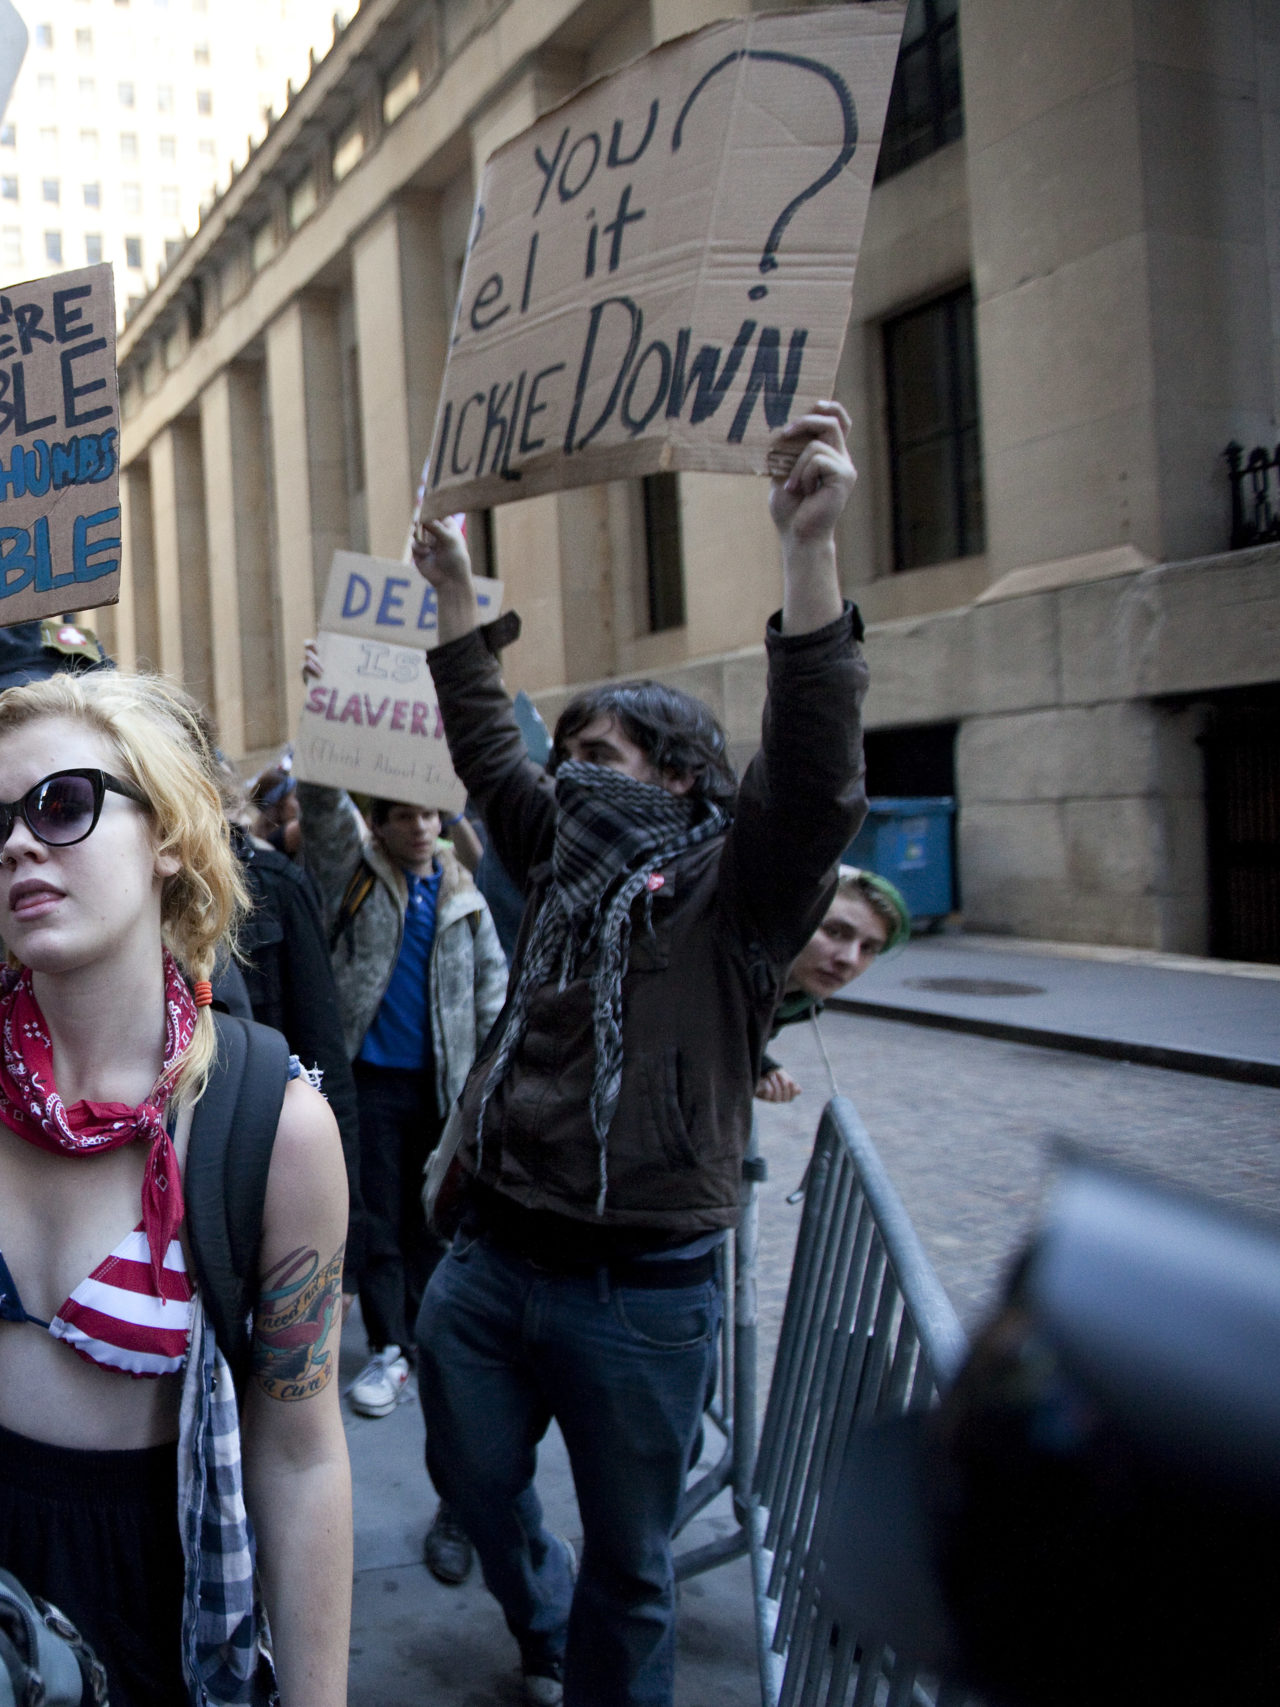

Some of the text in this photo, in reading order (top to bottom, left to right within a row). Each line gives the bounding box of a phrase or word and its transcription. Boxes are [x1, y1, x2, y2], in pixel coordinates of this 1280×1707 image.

[584, 184, 646, 280] it
[340, 572, 491, 631] DEB
[356, 643, 421, 684] IS
[263, 1298, 300, 1329] need
